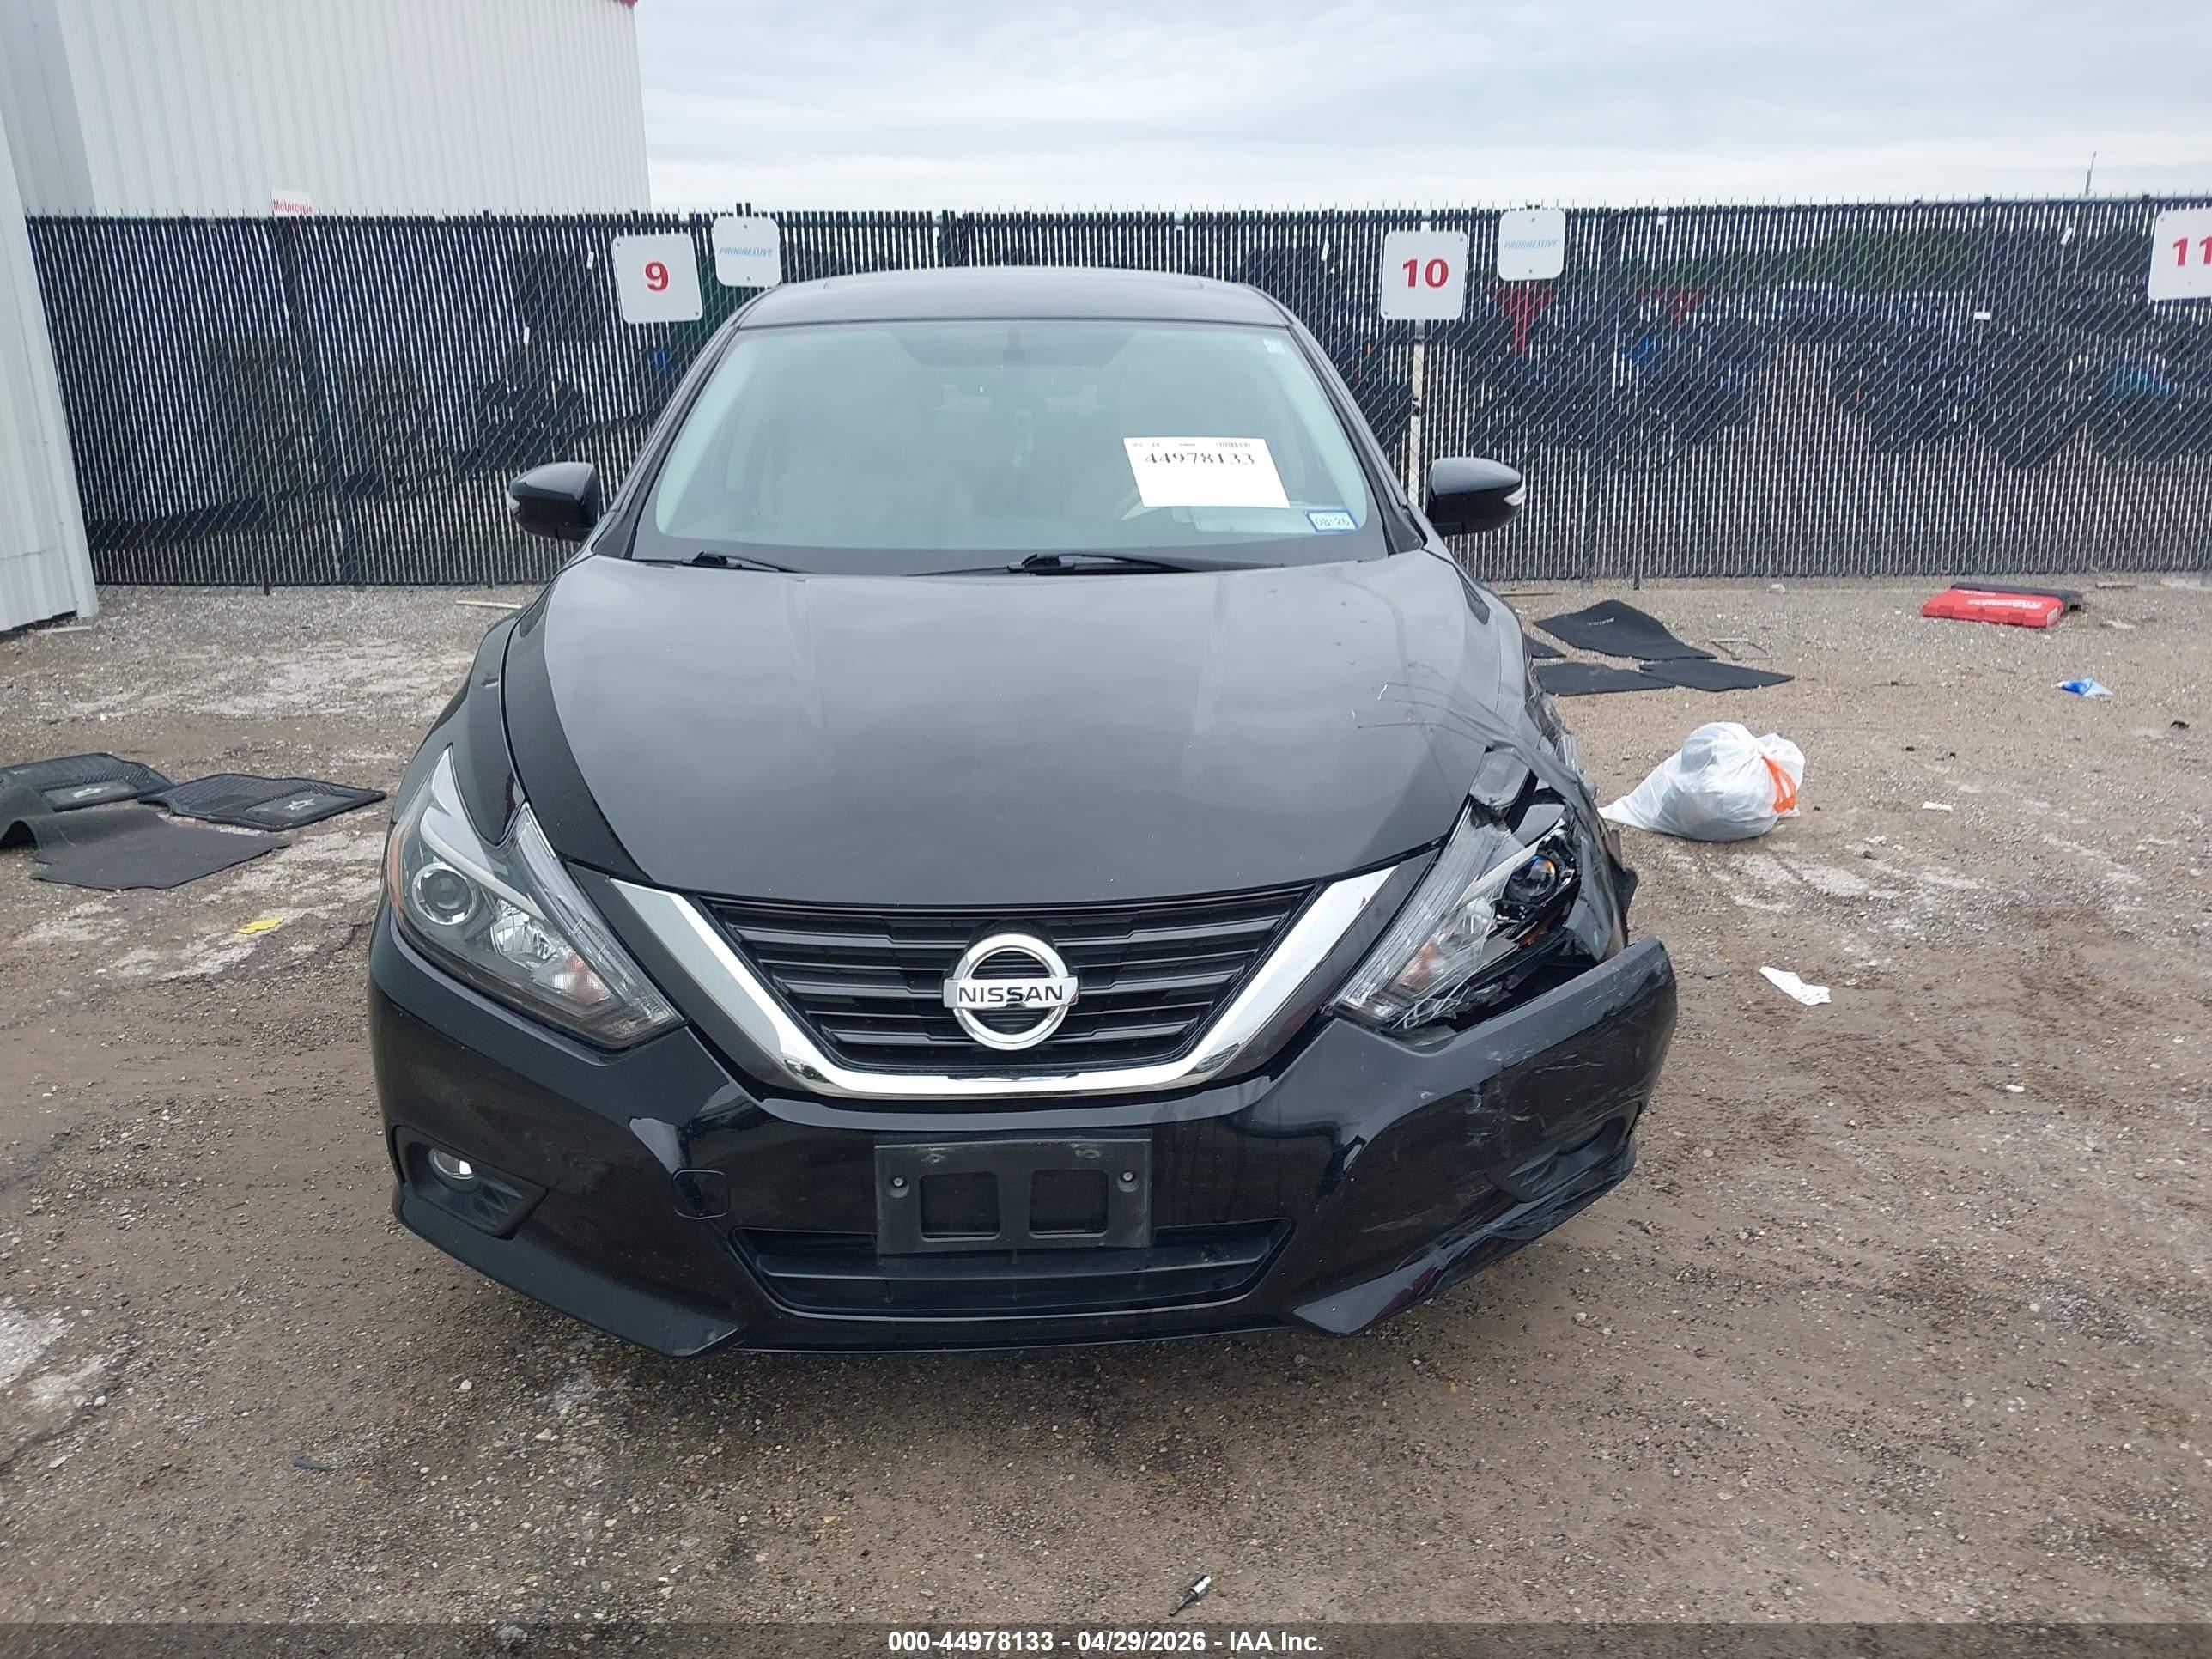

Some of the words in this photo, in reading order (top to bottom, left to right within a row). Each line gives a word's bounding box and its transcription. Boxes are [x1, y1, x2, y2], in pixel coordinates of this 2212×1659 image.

[272, 198, 313, 216] Motorcycle
[719, 246, 773, 258] PROGRESSIVE
[1504, 239, 1558, 250] PROGRESSIVE
[645, 262, 669, 292] 9
[1402, 258, 1449, 288] 10
[1146, 453, 1255, 465] 44978133
[958, 985, 1063, 1003] NISSAN
